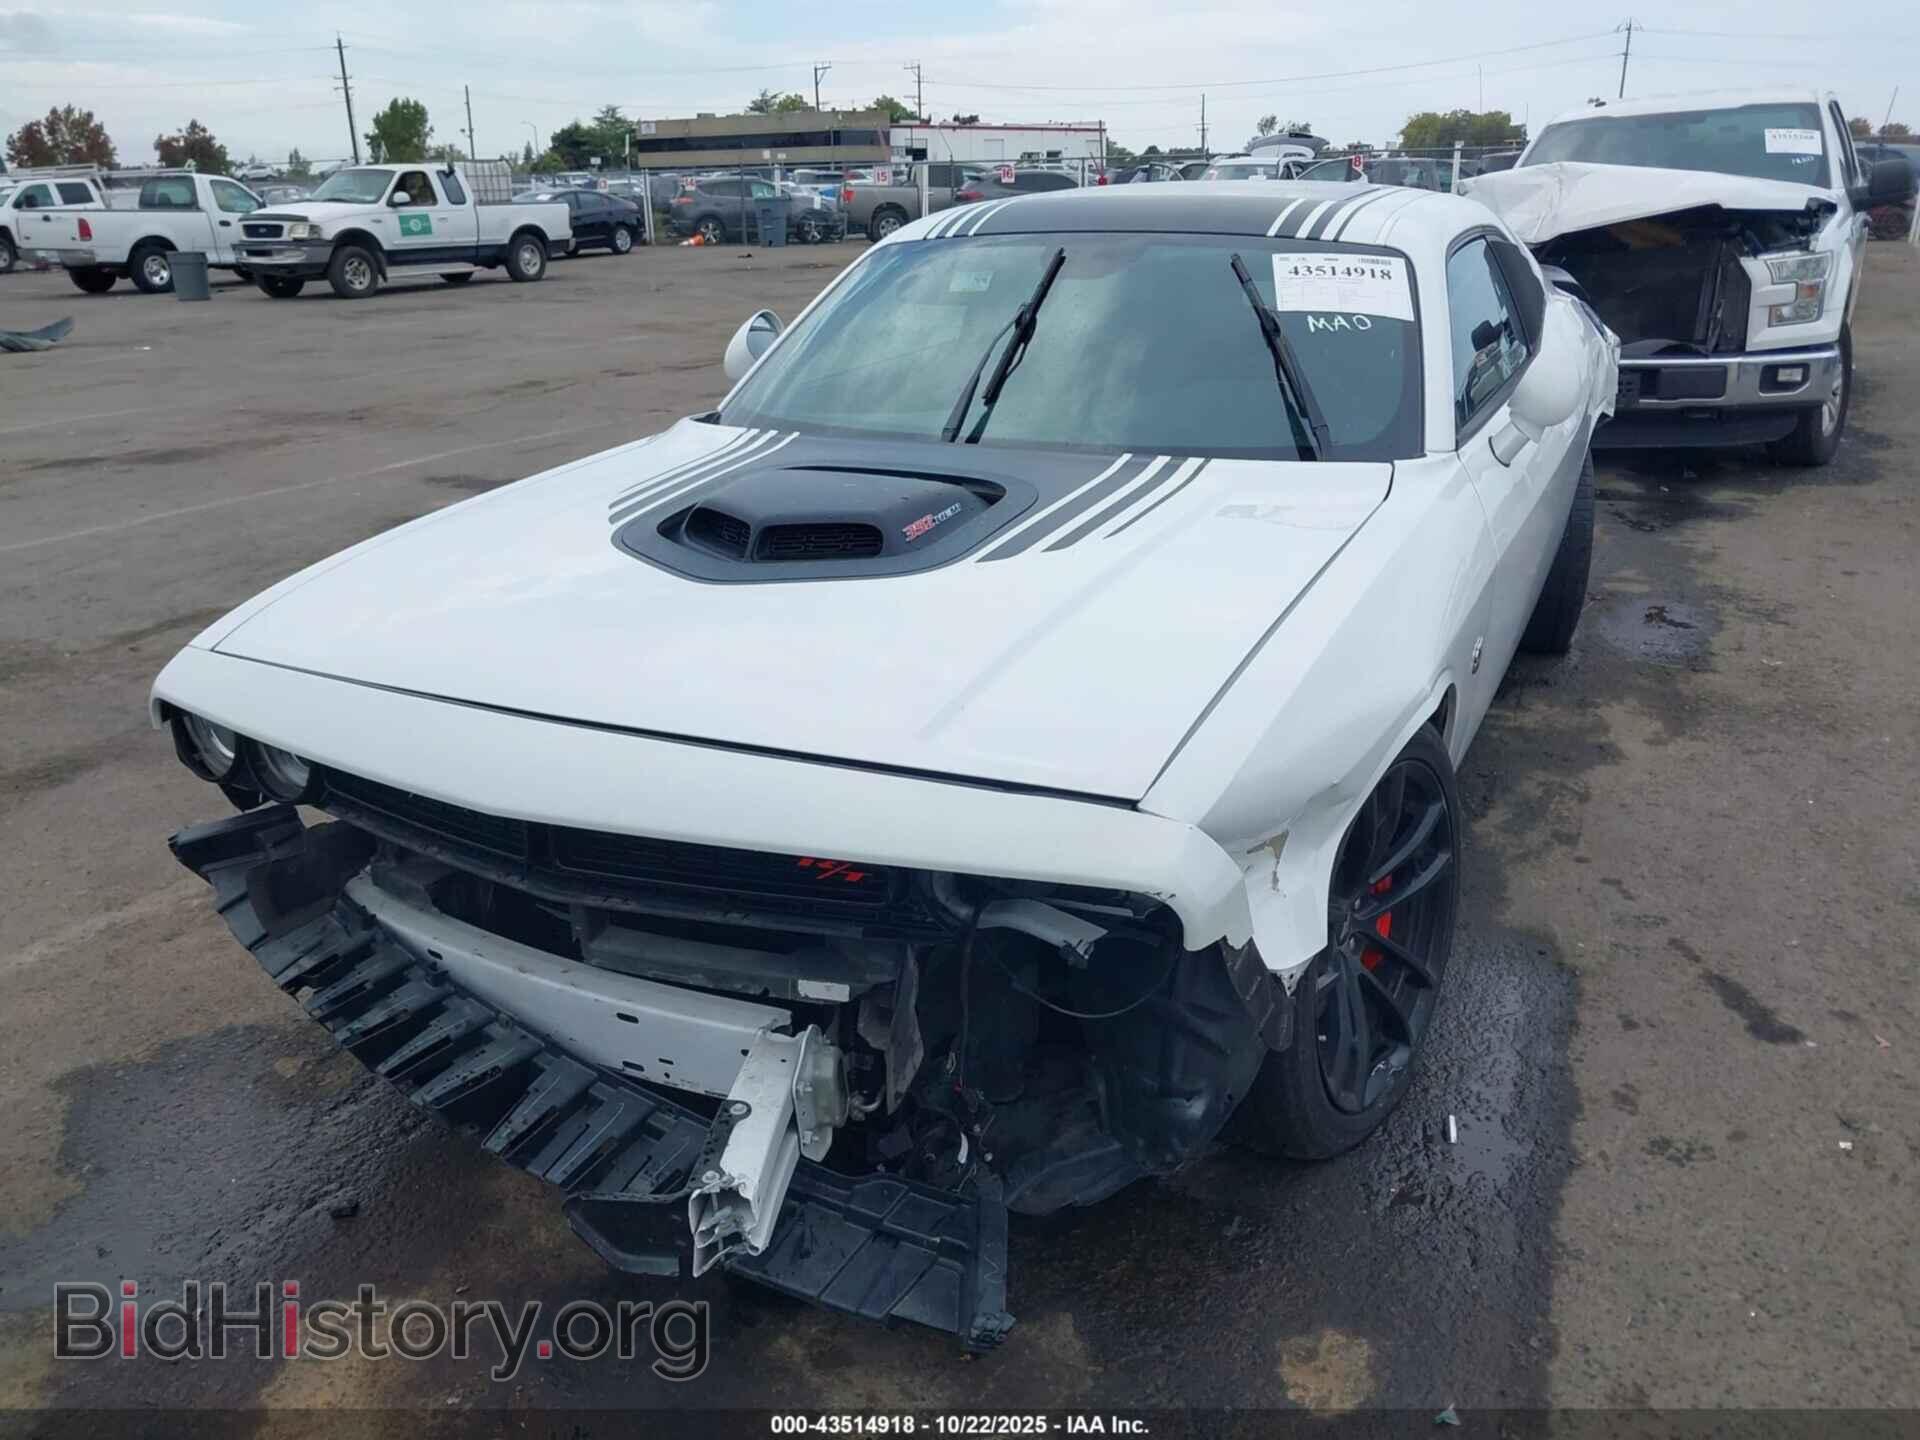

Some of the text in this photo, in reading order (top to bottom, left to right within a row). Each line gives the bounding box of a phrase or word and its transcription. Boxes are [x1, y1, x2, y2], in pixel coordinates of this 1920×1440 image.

[876, 170, 888, 182] 15
[1002, 168, 1013, 179] 16
[1288, 265, 1393, 280] 43514918
